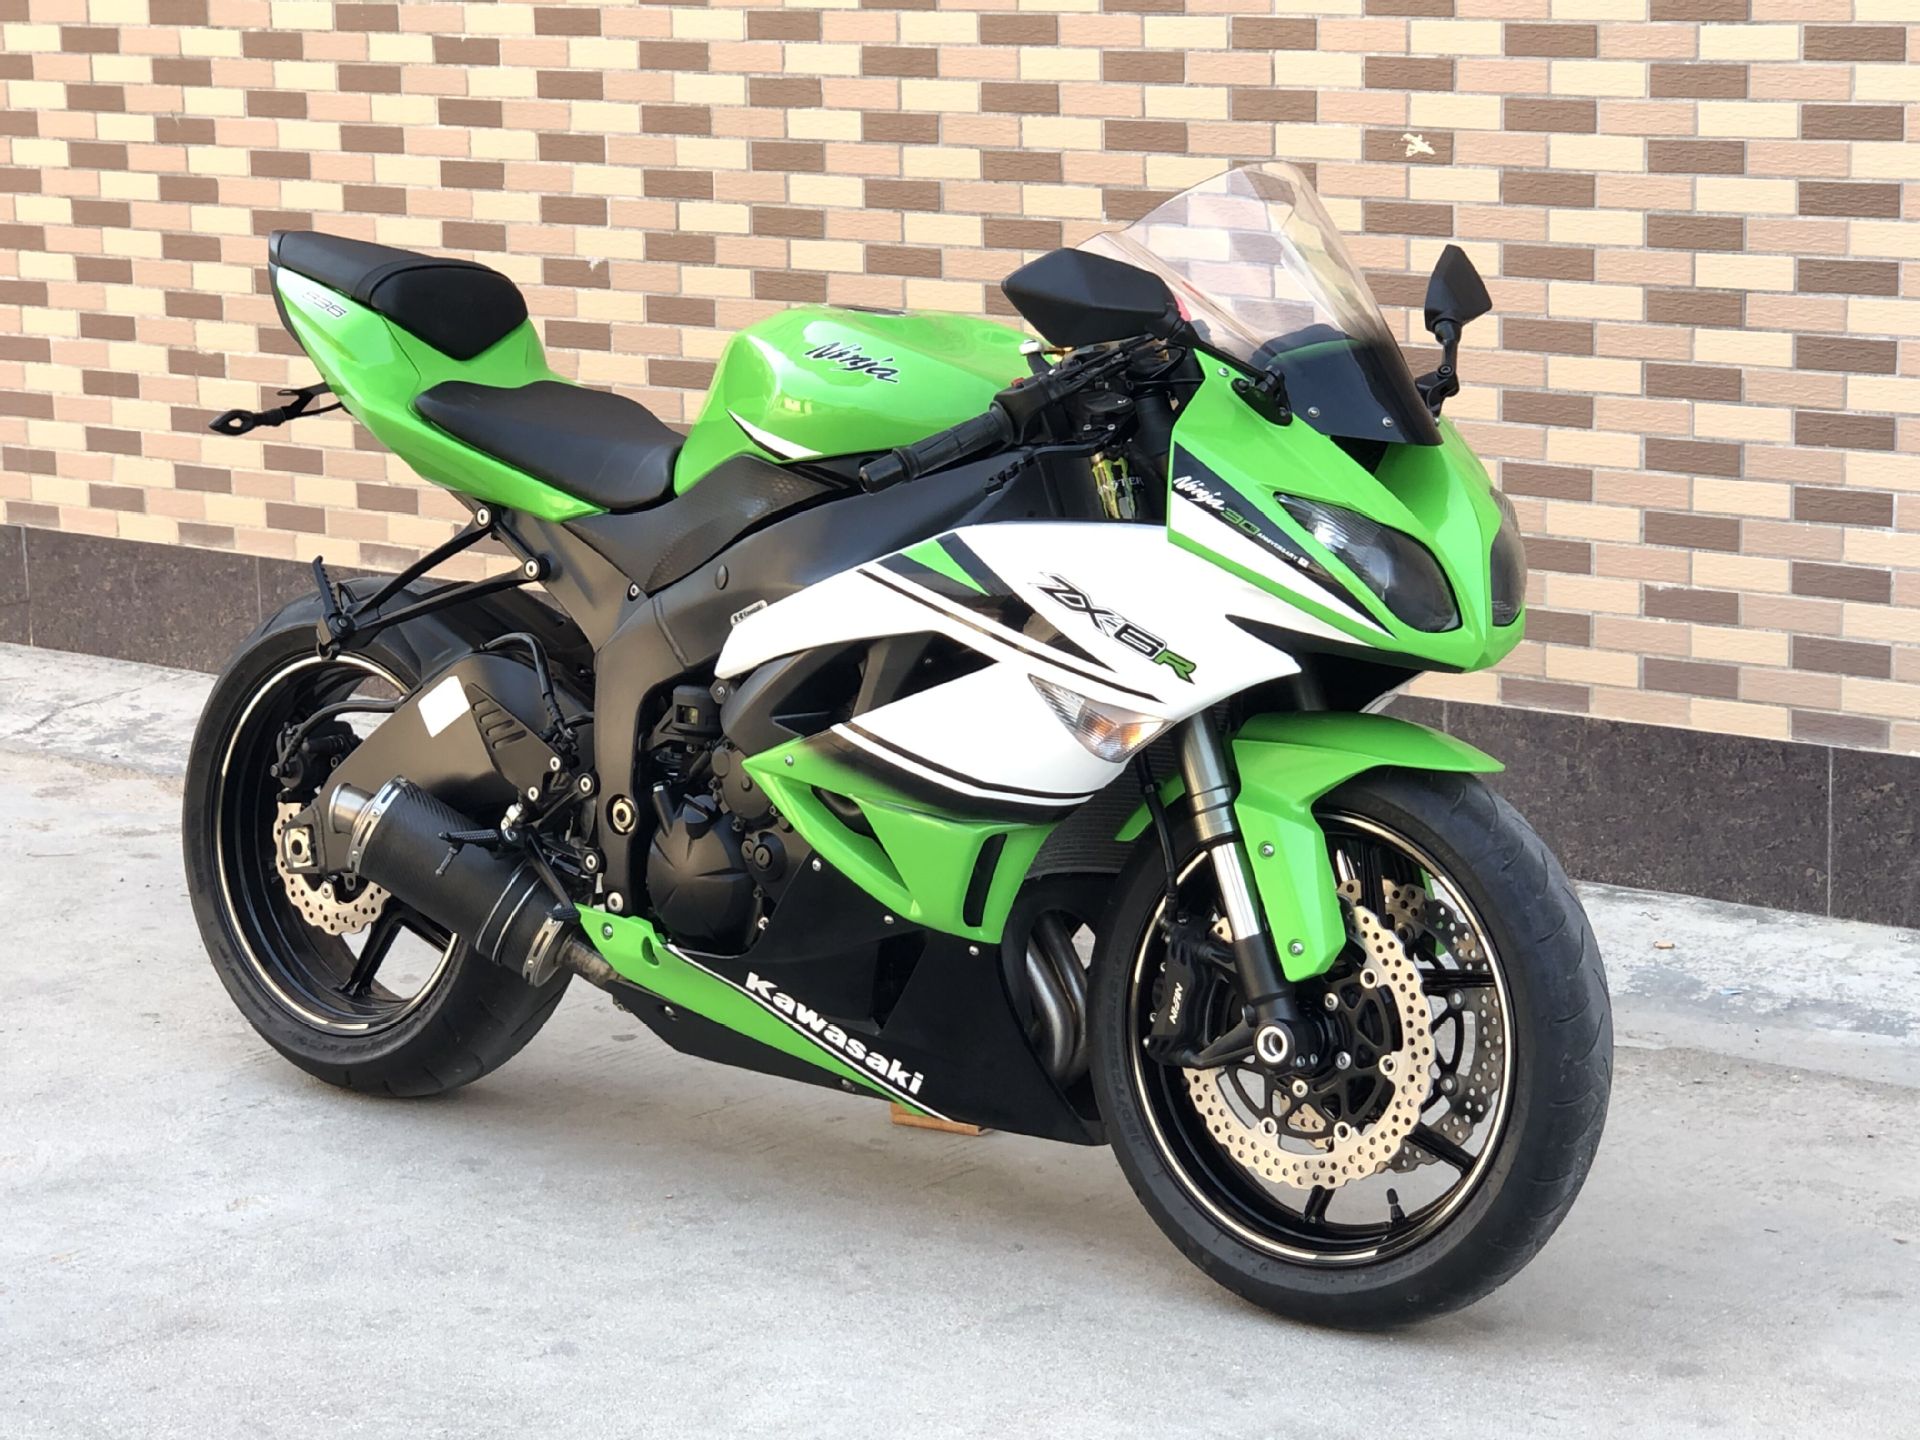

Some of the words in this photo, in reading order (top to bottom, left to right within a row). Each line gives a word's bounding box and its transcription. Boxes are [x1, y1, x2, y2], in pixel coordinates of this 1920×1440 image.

[804, 341, 899, 384] Ninja
[1173, 475, 1225, 511] Ninja
[745, 971, 924, 1095] Kawasaki
